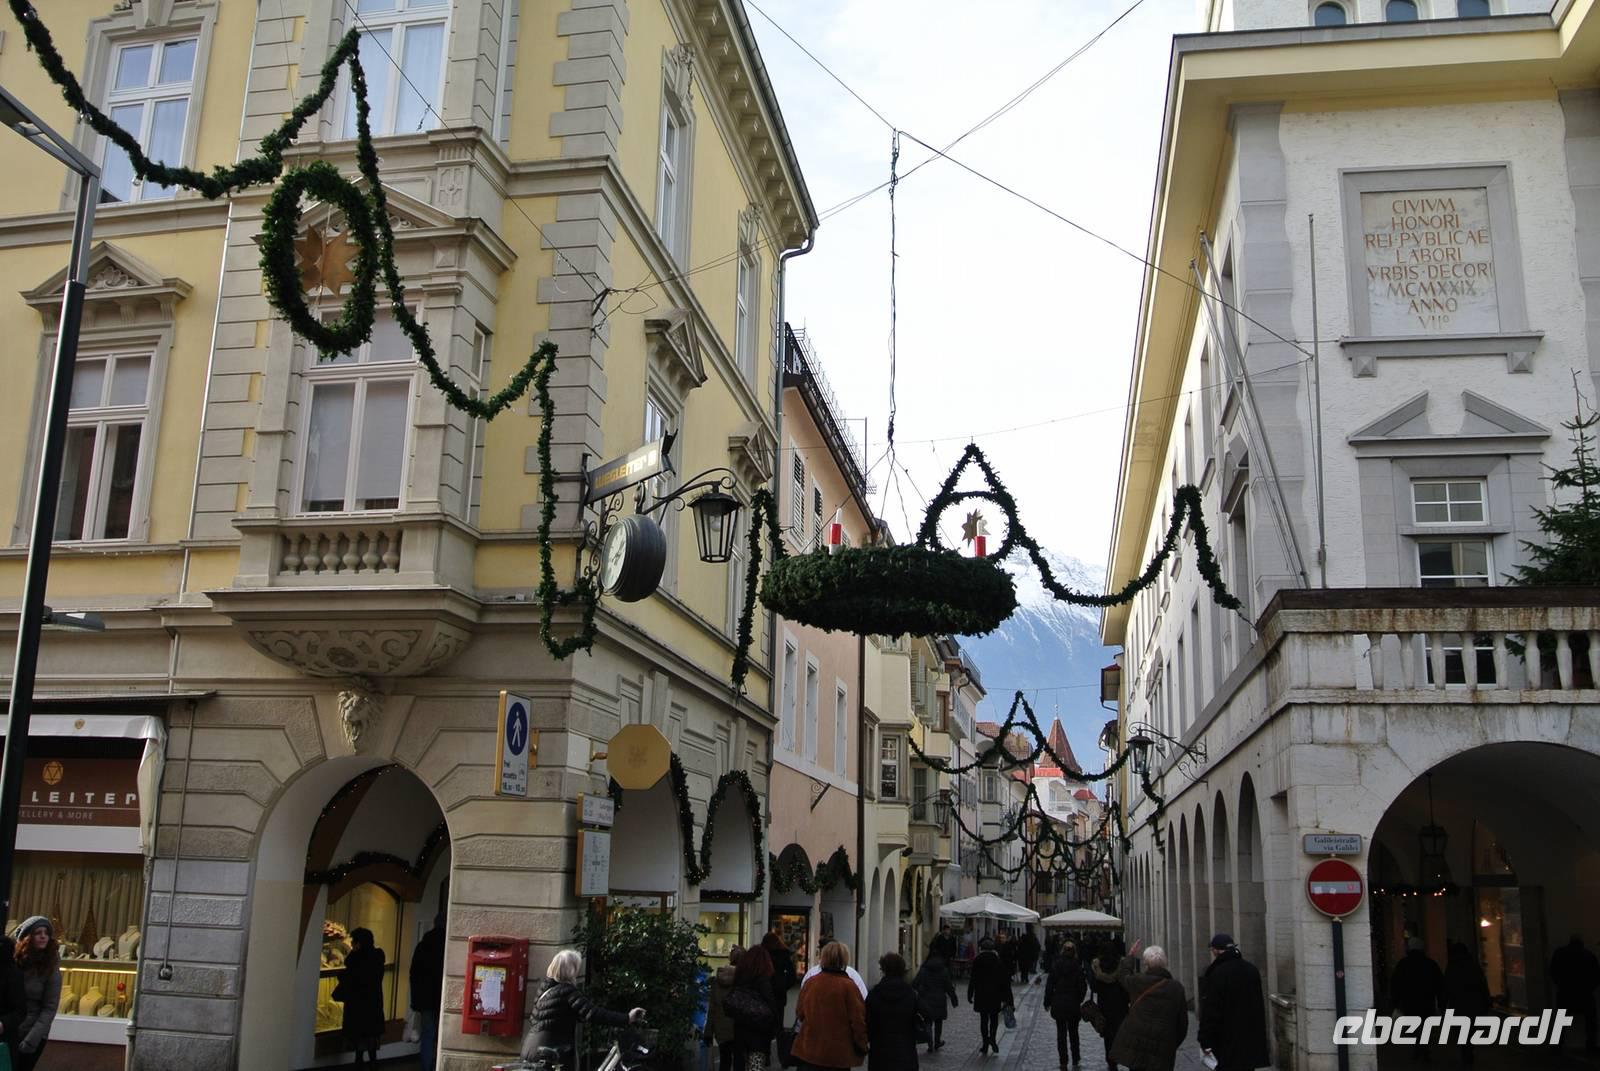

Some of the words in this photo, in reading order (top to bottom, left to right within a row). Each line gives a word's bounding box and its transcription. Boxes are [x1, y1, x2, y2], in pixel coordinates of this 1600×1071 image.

[1392, 198, 1456, 214] CIVIVM
[1391, 214, 1460, 231] HONORI
[1396, 247, 1461, 263] LABORI
[1387, 280, 1476, 297] MCMXXIX
[1408, 297, 1458, 313] ANNO
[18, 809, 54, 818] ELLERY
